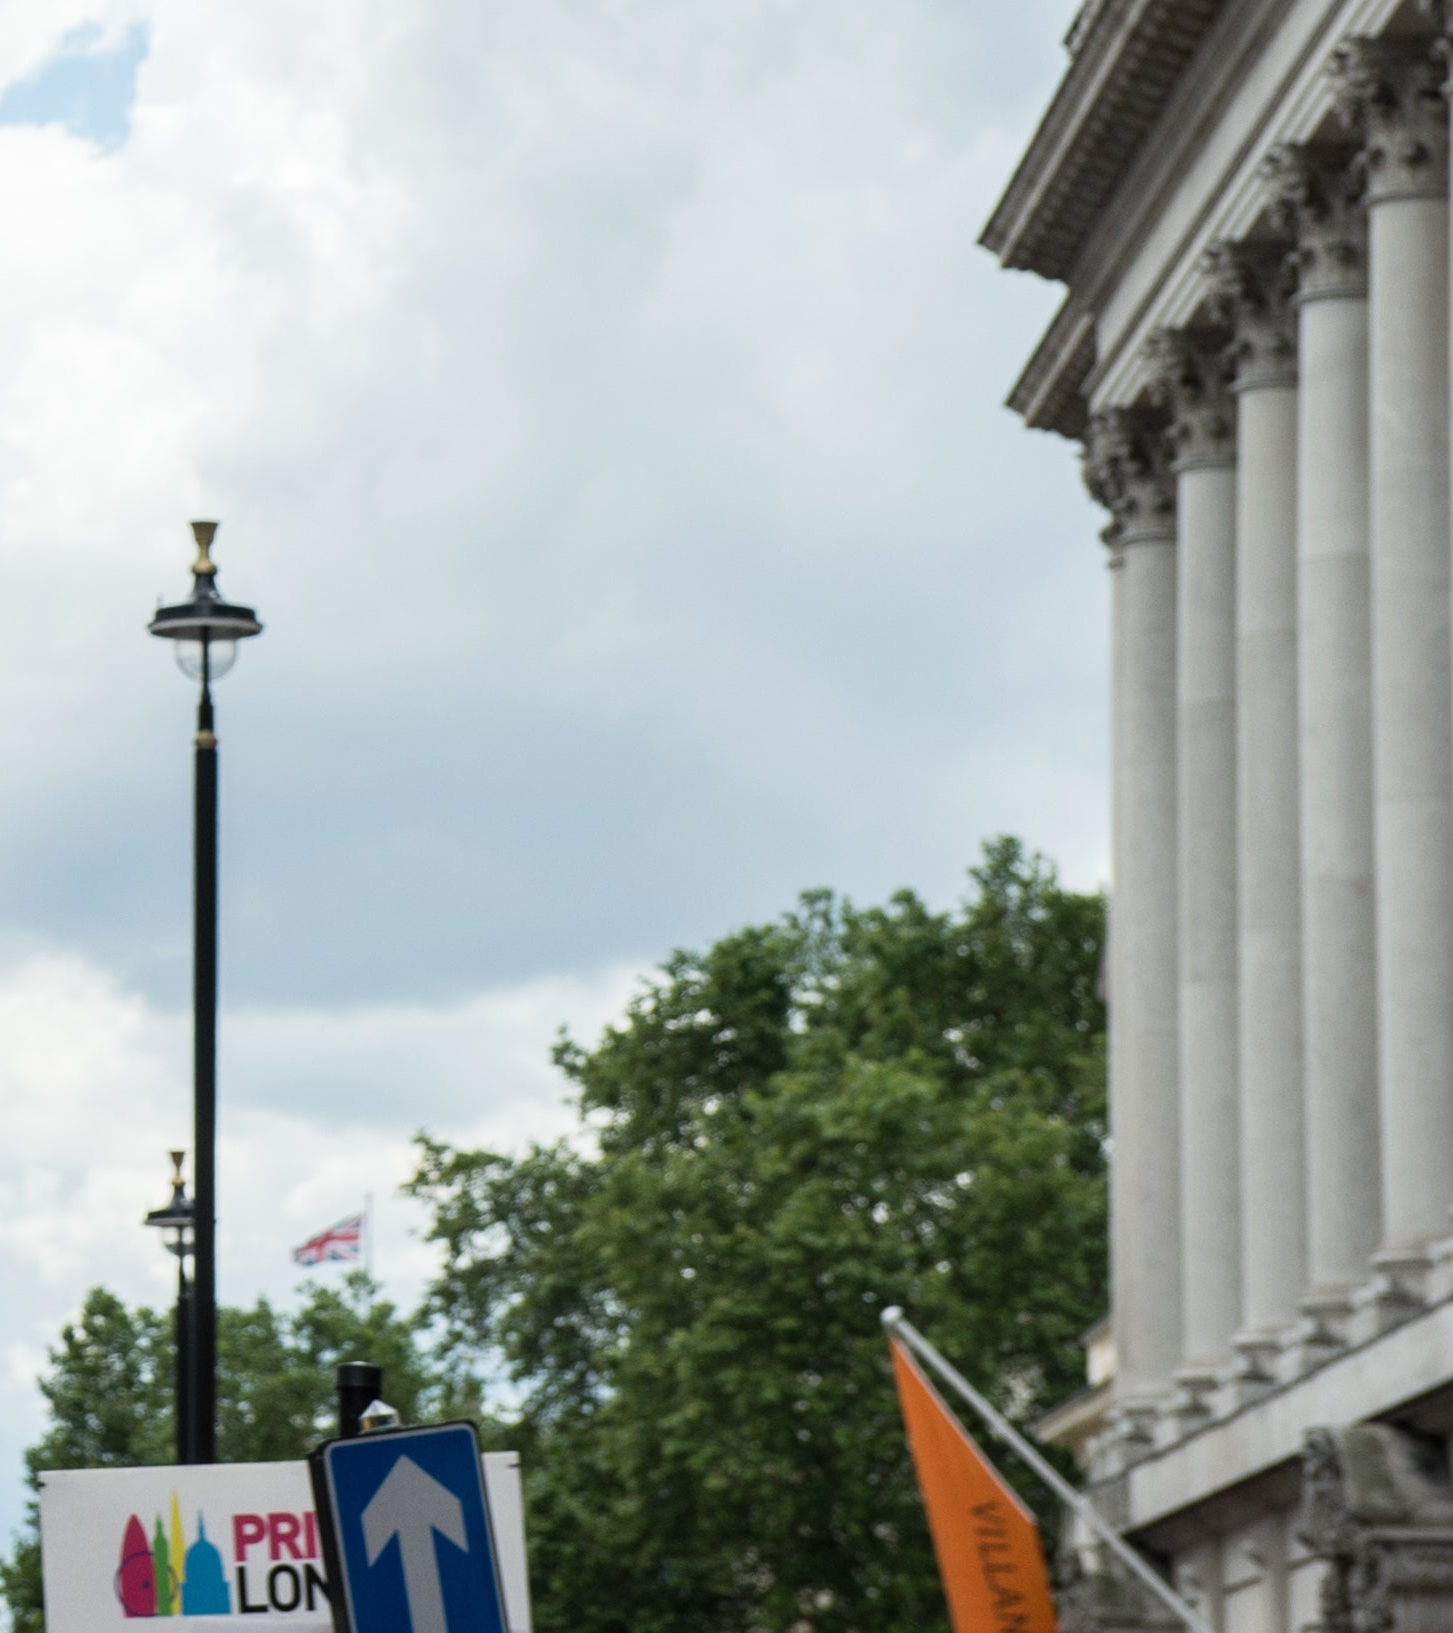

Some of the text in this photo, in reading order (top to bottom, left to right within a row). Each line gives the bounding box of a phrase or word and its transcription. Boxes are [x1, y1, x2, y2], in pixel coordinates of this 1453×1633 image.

[232, 1511, 318, 1562] PRI
[235, 1563, 331, 1614] LON
[970, 1499, 1031, 1633] VILLAN
